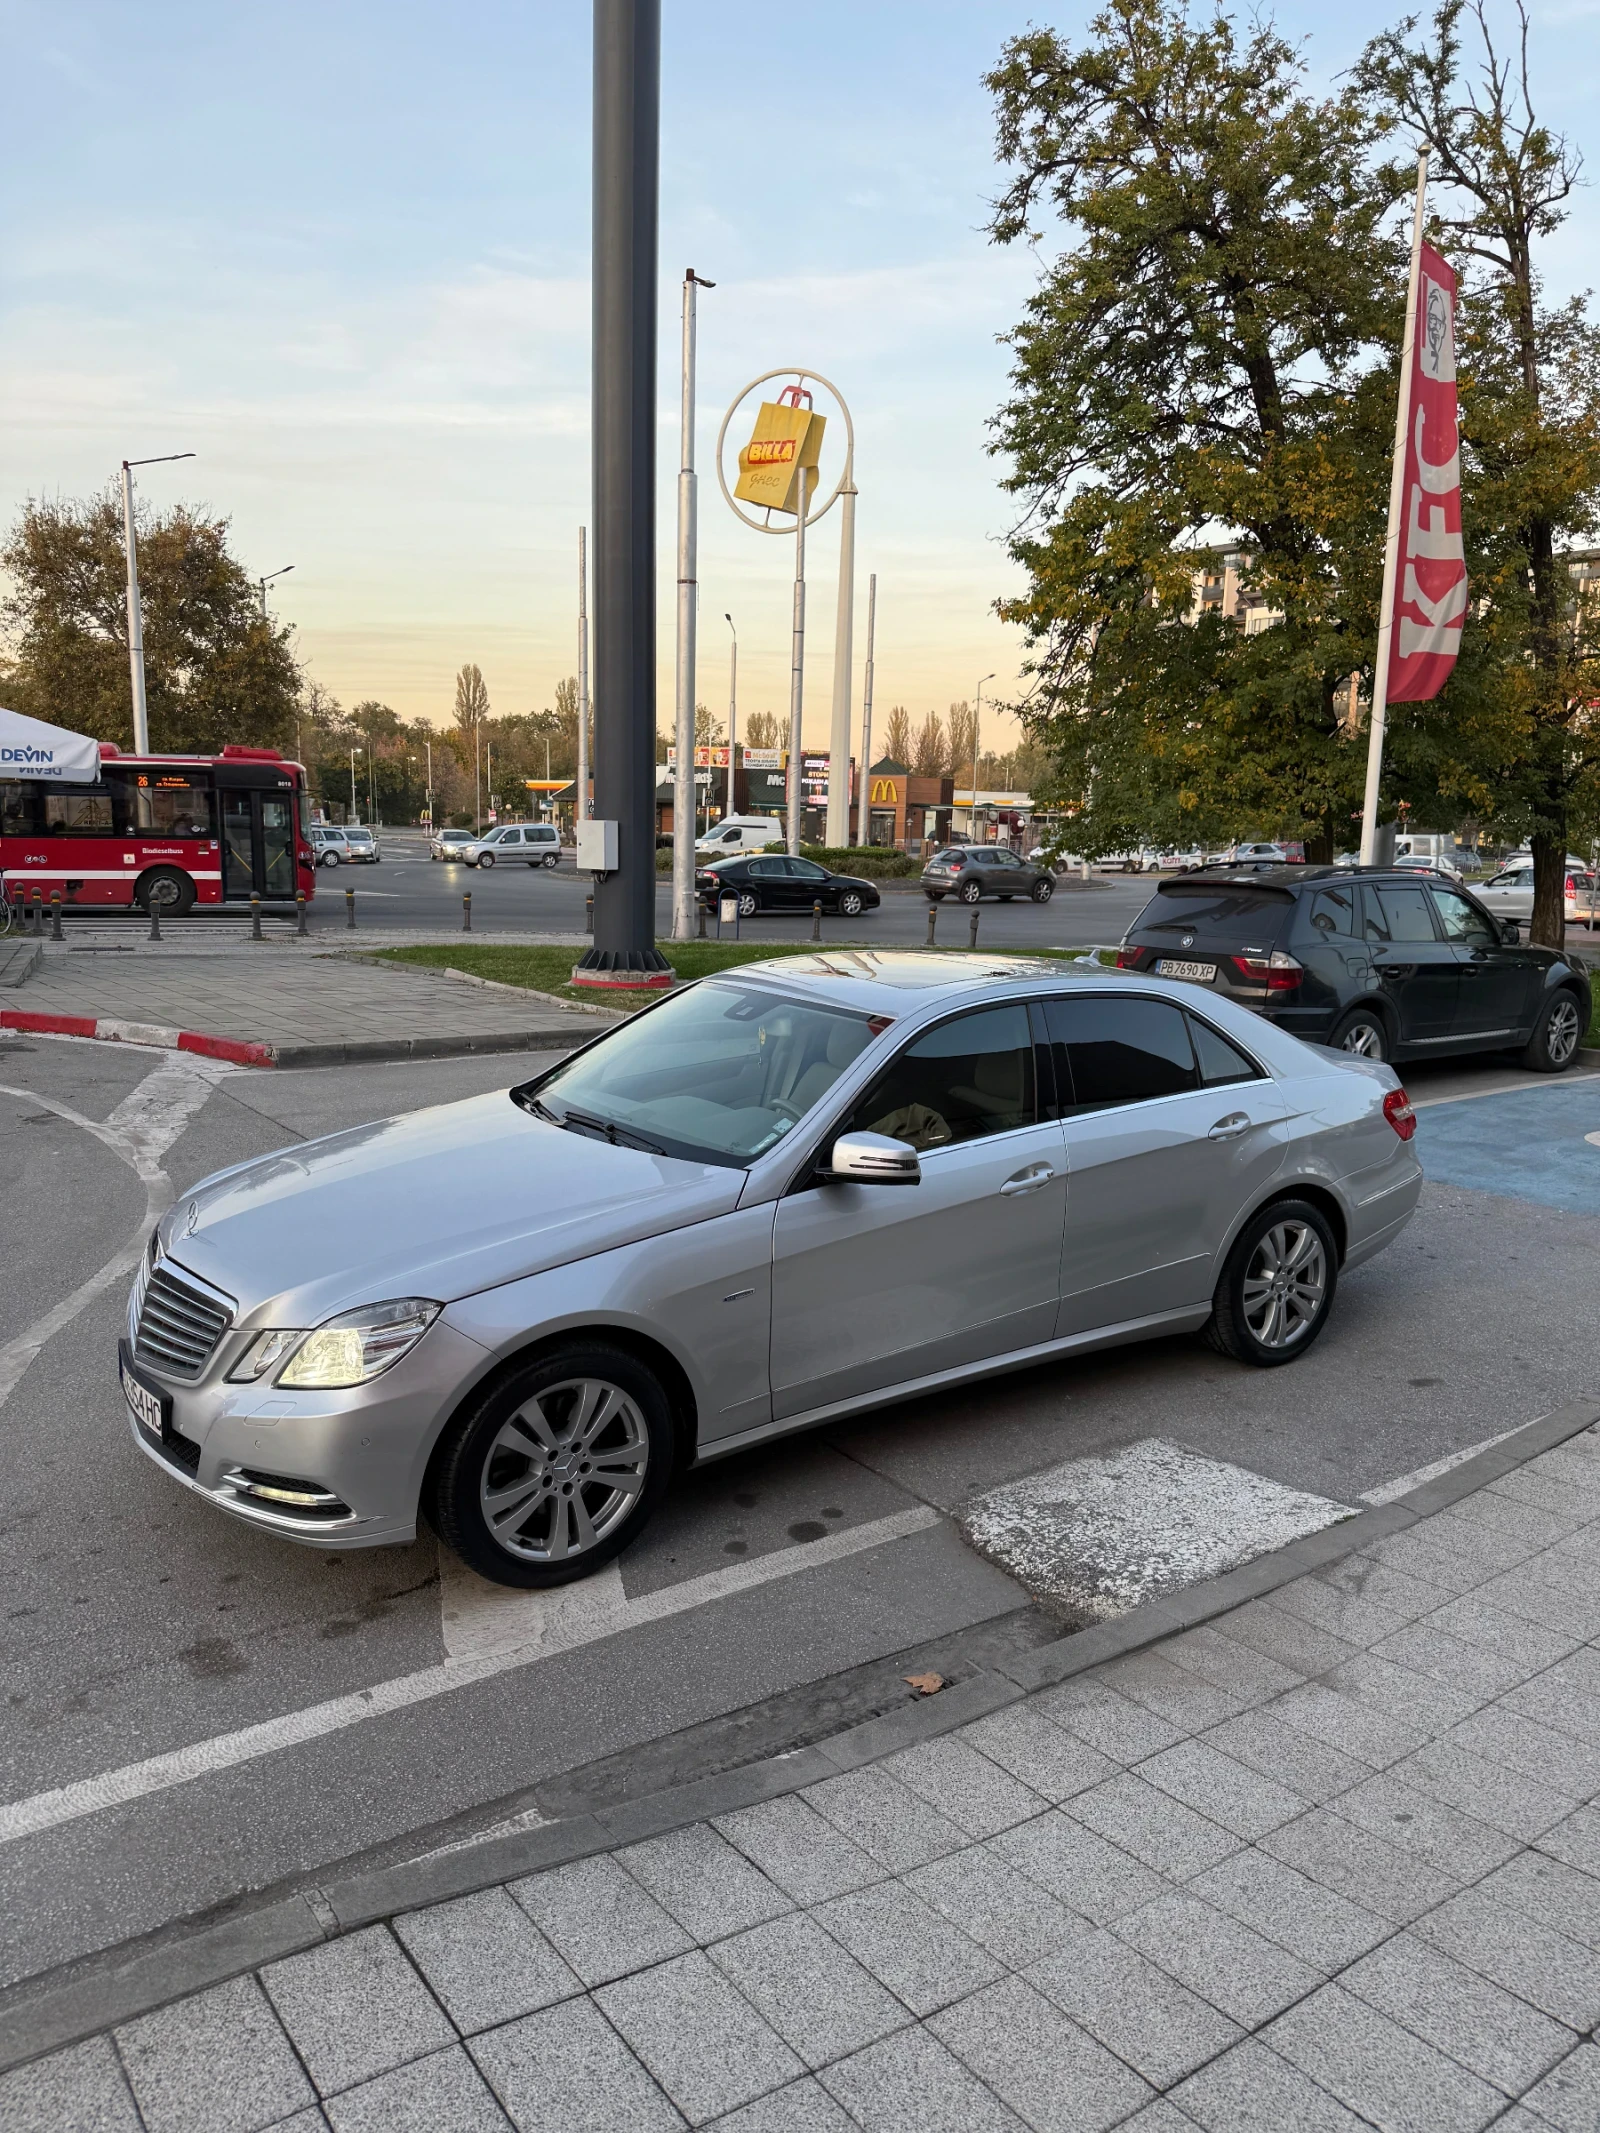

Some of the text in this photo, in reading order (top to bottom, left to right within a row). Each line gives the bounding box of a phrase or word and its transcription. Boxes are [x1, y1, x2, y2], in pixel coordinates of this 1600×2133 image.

[748, 441, 795, 463] BILLA
[1400, 403, 1467, 658] KFC
[1, 748, 53, 762] DEVIN
[138, 776, 148, 787] 26
[1161, 961, 1214, 977] PB 7690 XP
